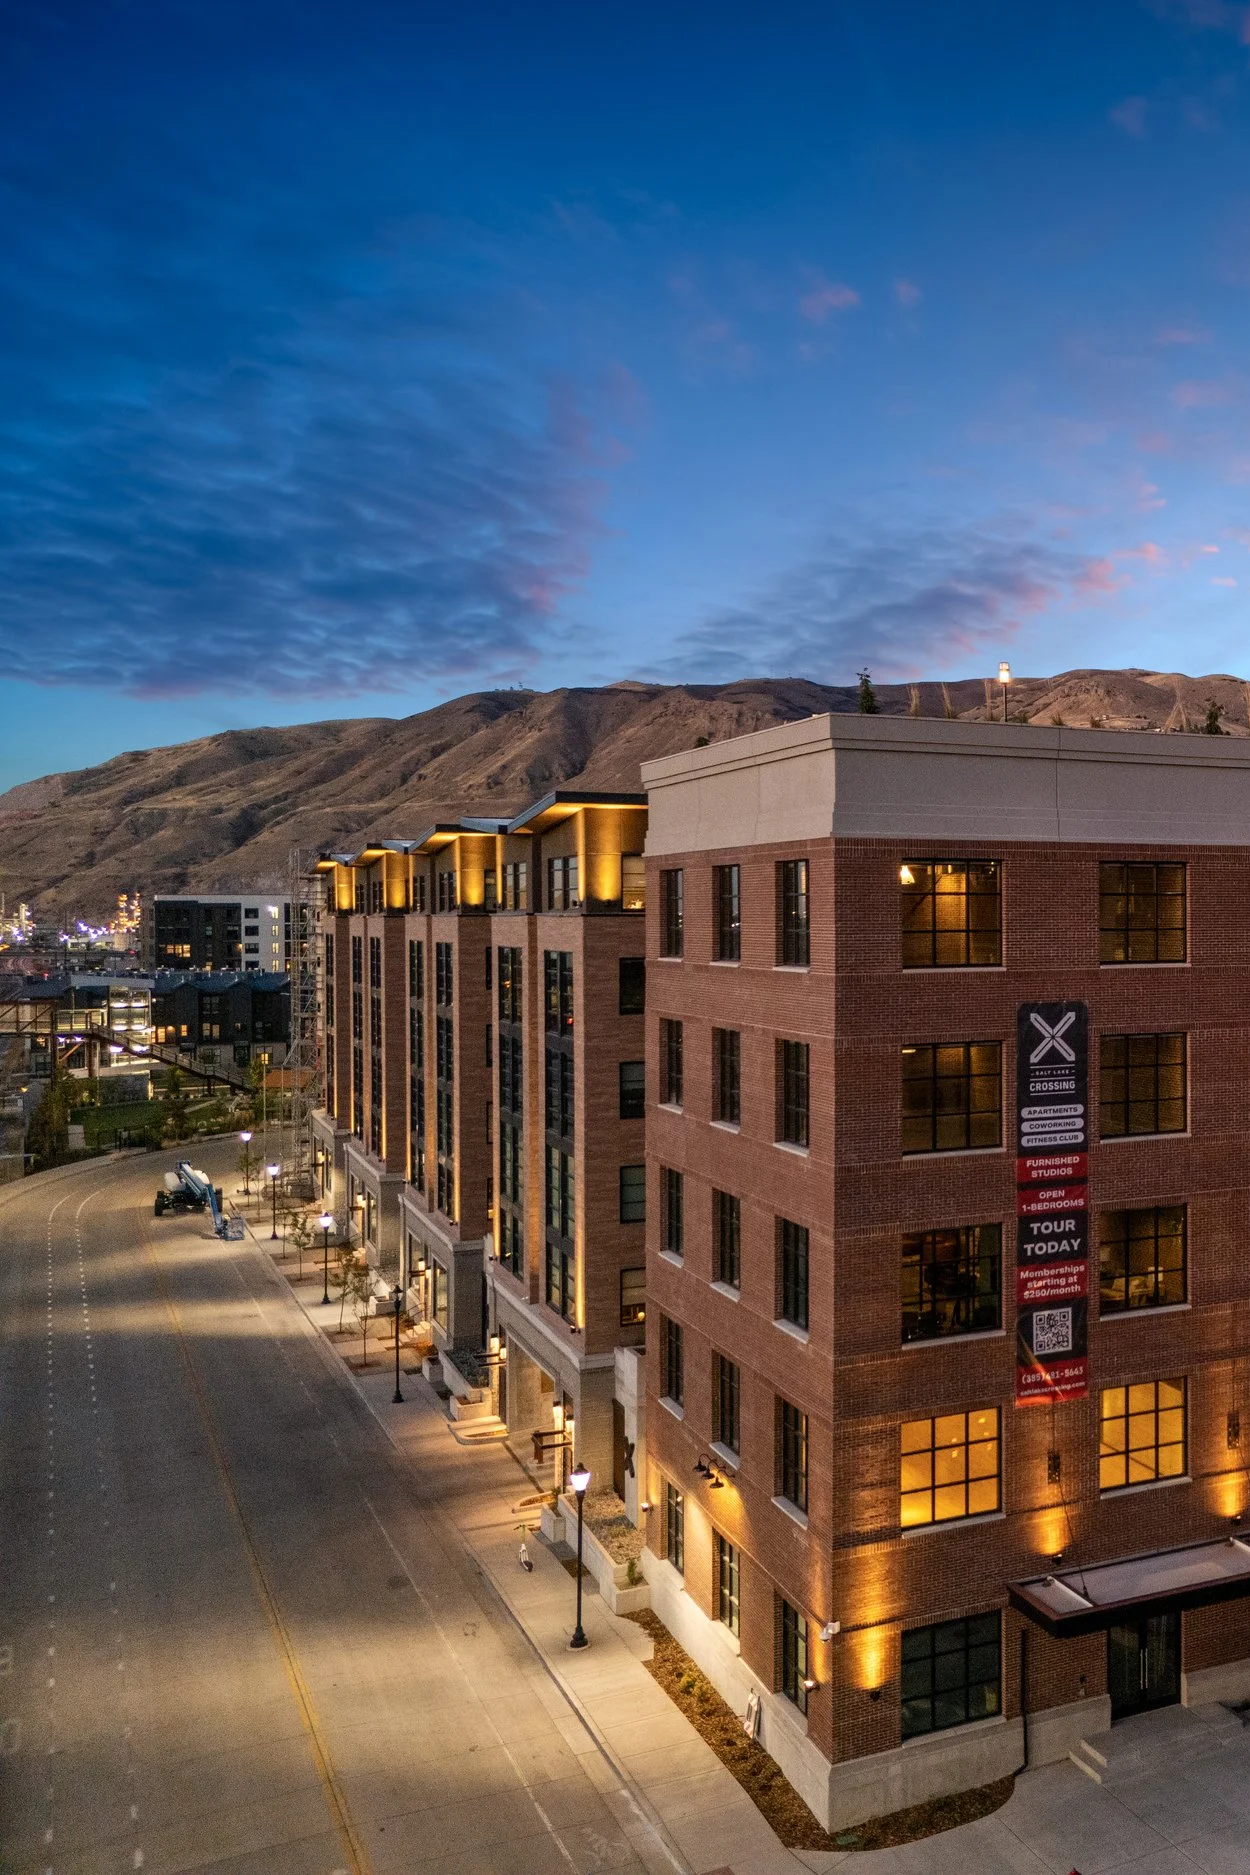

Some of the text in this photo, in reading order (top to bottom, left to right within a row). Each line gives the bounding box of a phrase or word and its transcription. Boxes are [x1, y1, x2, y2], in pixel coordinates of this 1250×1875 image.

[1030, 1080, 1075, 1091] CROSSING
[1027, 1106, 1078, 1116] APARTMENTS
[1029, 1120, 1076, 1130] COWORKING
[1027, 1133, 1079, 1145] FITNESS CLUB
[1026, 1156, 1080, 1167] FURNISHED
[1031, 1167, 1073, 1178] STUDIOS
[1039, 1190, 1065, 1199] OPEN
[1022, 1199, 1085, 1212] 1-BEDROOMS
[1030, 1219, 1076, 1235] TOUR
[1023, 1238, 1081, 1256] TODAY
[1020, 1264, 1085, 1279] Memberships
[1027, 1275, 1077, 1289] starting at
[1023, 1284, 1081, 1300] $250/month
